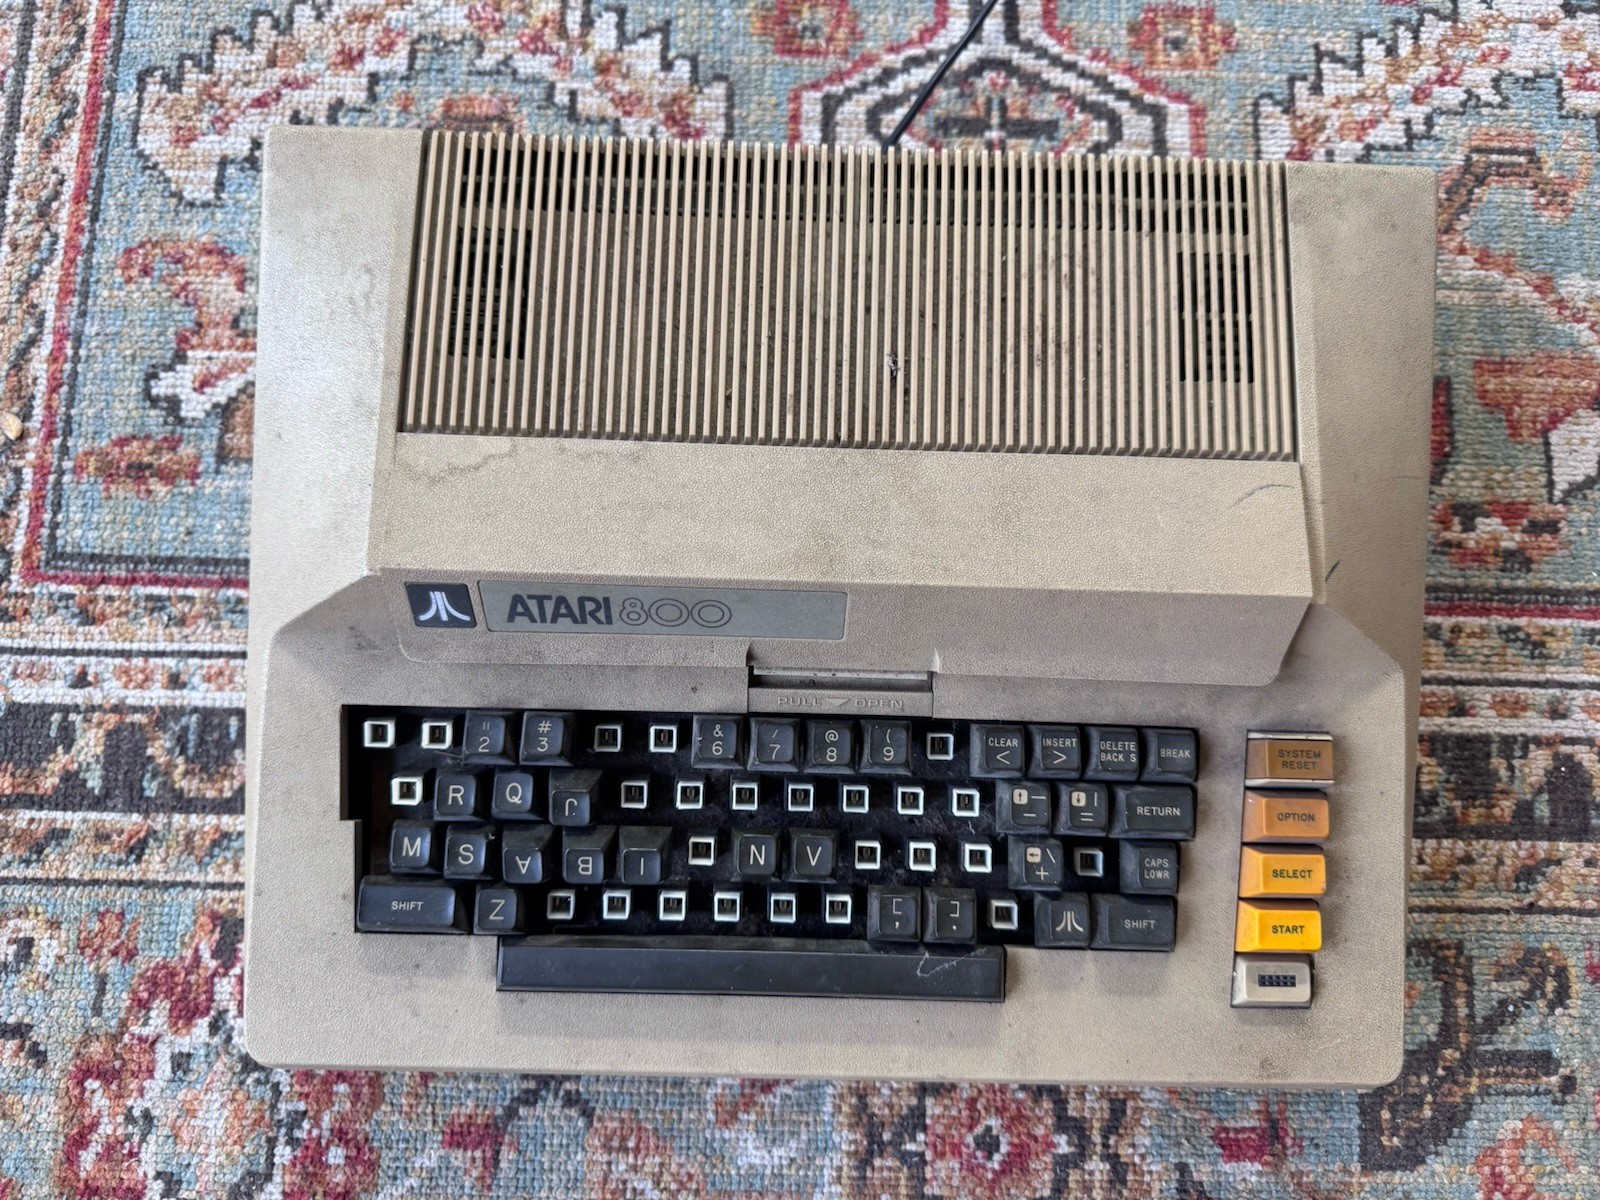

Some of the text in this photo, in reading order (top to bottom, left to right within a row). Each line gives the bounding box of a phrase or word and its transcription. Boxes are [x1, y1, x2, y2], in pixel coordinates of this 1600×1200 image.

[506, 593, 732, 627] ATARI 800
[777, 696, 904, 709] PULL OPEN
[537, 720, 551, 734] #
[713, 724, 724, 738] &
[825, 730, 838, 744] @
[988, 737, 1018, 748] CLEAR
[1042, 738, 1077, 748] INSERT
[478, 736, 490, 753] 2
[537, 737, 549, 752] 3
[712, 741, 723, 756] 6
[1100, 741, 1136, 751] DELETE
[769, 744, 781, 760] 7
[826, 747, 837, 763] 8
[883, 747, 894, 761] 9
[1100, 753, 1137, 763] BACK S
[1160, 749, 1191, 759] BREAK
[1278, 749, 1321, 759] SYSTEM
[1282, 761, 1317, 770] RESET
[448, 785, 465, 806] R
[506, 782, 522, 804] Q
[1136, 806, 1181, 816] RETURN
[1277, 812, 1315, 822] OPTION
[402, 836, 422, 858] M
[458, 844, 474, 864] S
[750, 844, 766, 866] N
[806, 845, 822, 866] V
[515, 856, 531, 875] A
[578, 856, 593, 875] B
[1144, 858, 1169, 868] CAPS
[1144, 870, 1170, 879] LOWR
[1272, 869, 1313, 879] SELECT
[391, 901, 423, 911] SHIFT
[489, 899, 505, 920] Z
[1124, 919, 1156, 929] SHIFT
[1272, 925, 1305, 935] START
